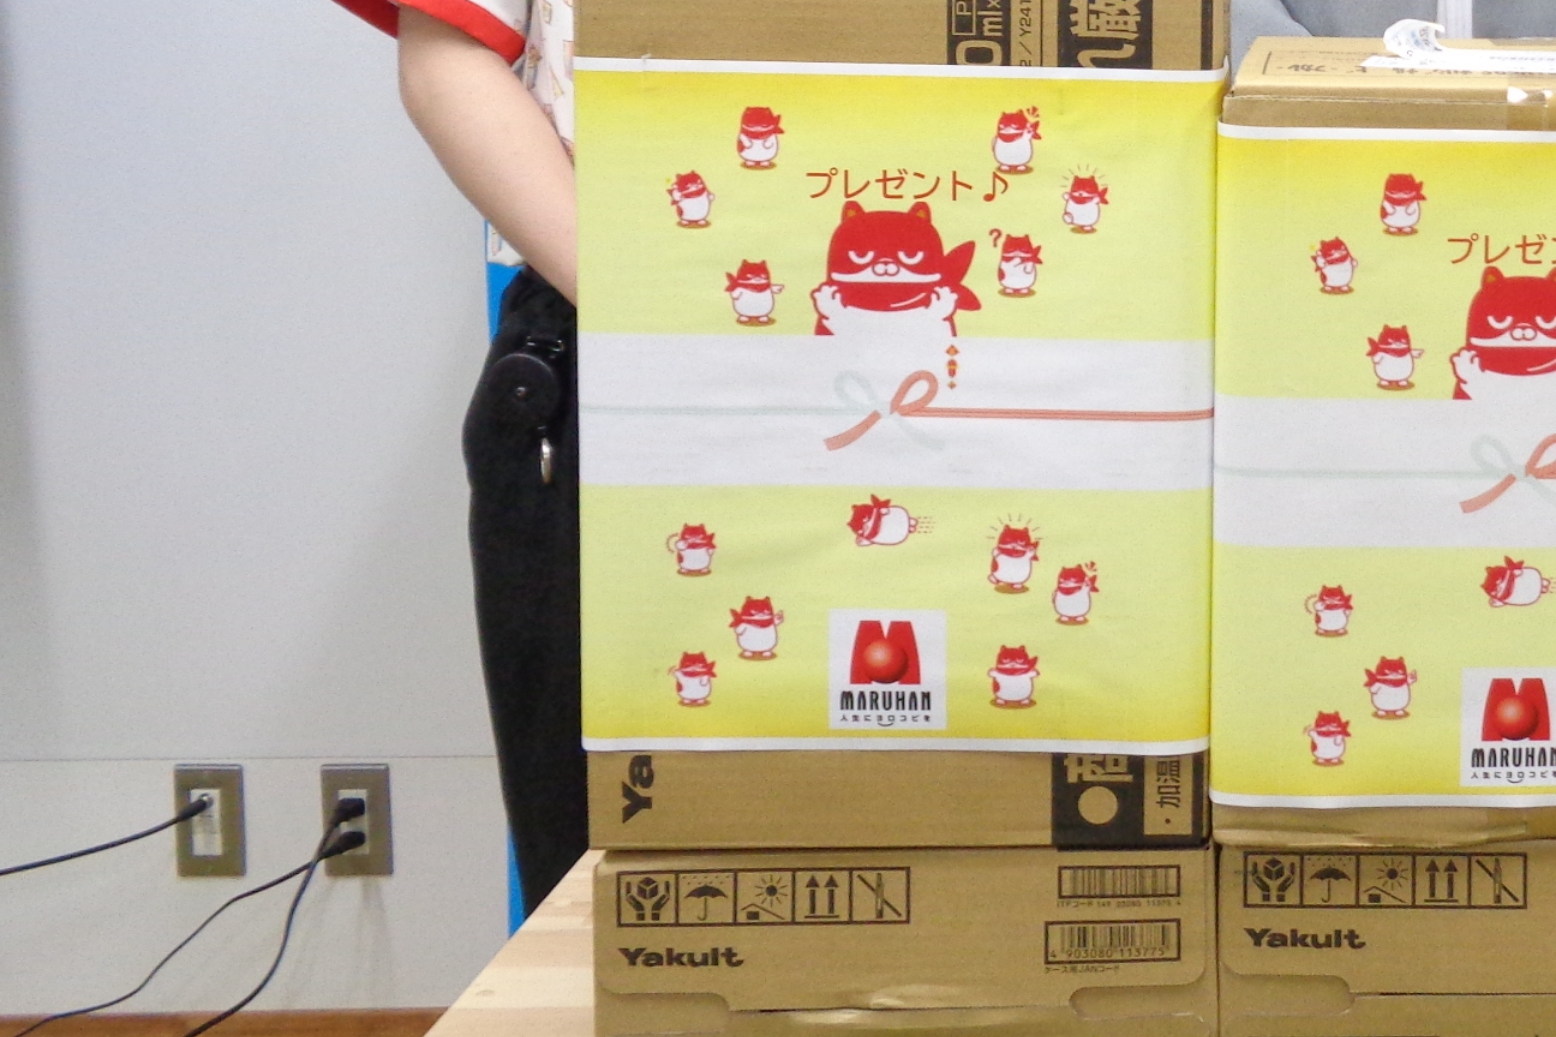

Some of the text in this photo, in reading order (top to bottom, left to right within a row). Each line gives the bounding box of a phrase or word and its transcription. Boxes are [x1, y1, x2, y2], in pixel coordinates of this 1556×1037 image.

[840, 690, 931, 711] MARUHAN
[1243, 927, 1367, 949] Yakult
[617, 946, 745, 968] Yakult
[1066, 947, 1113, 959] 903080
[1119, 946, 1165, 958] 113775
